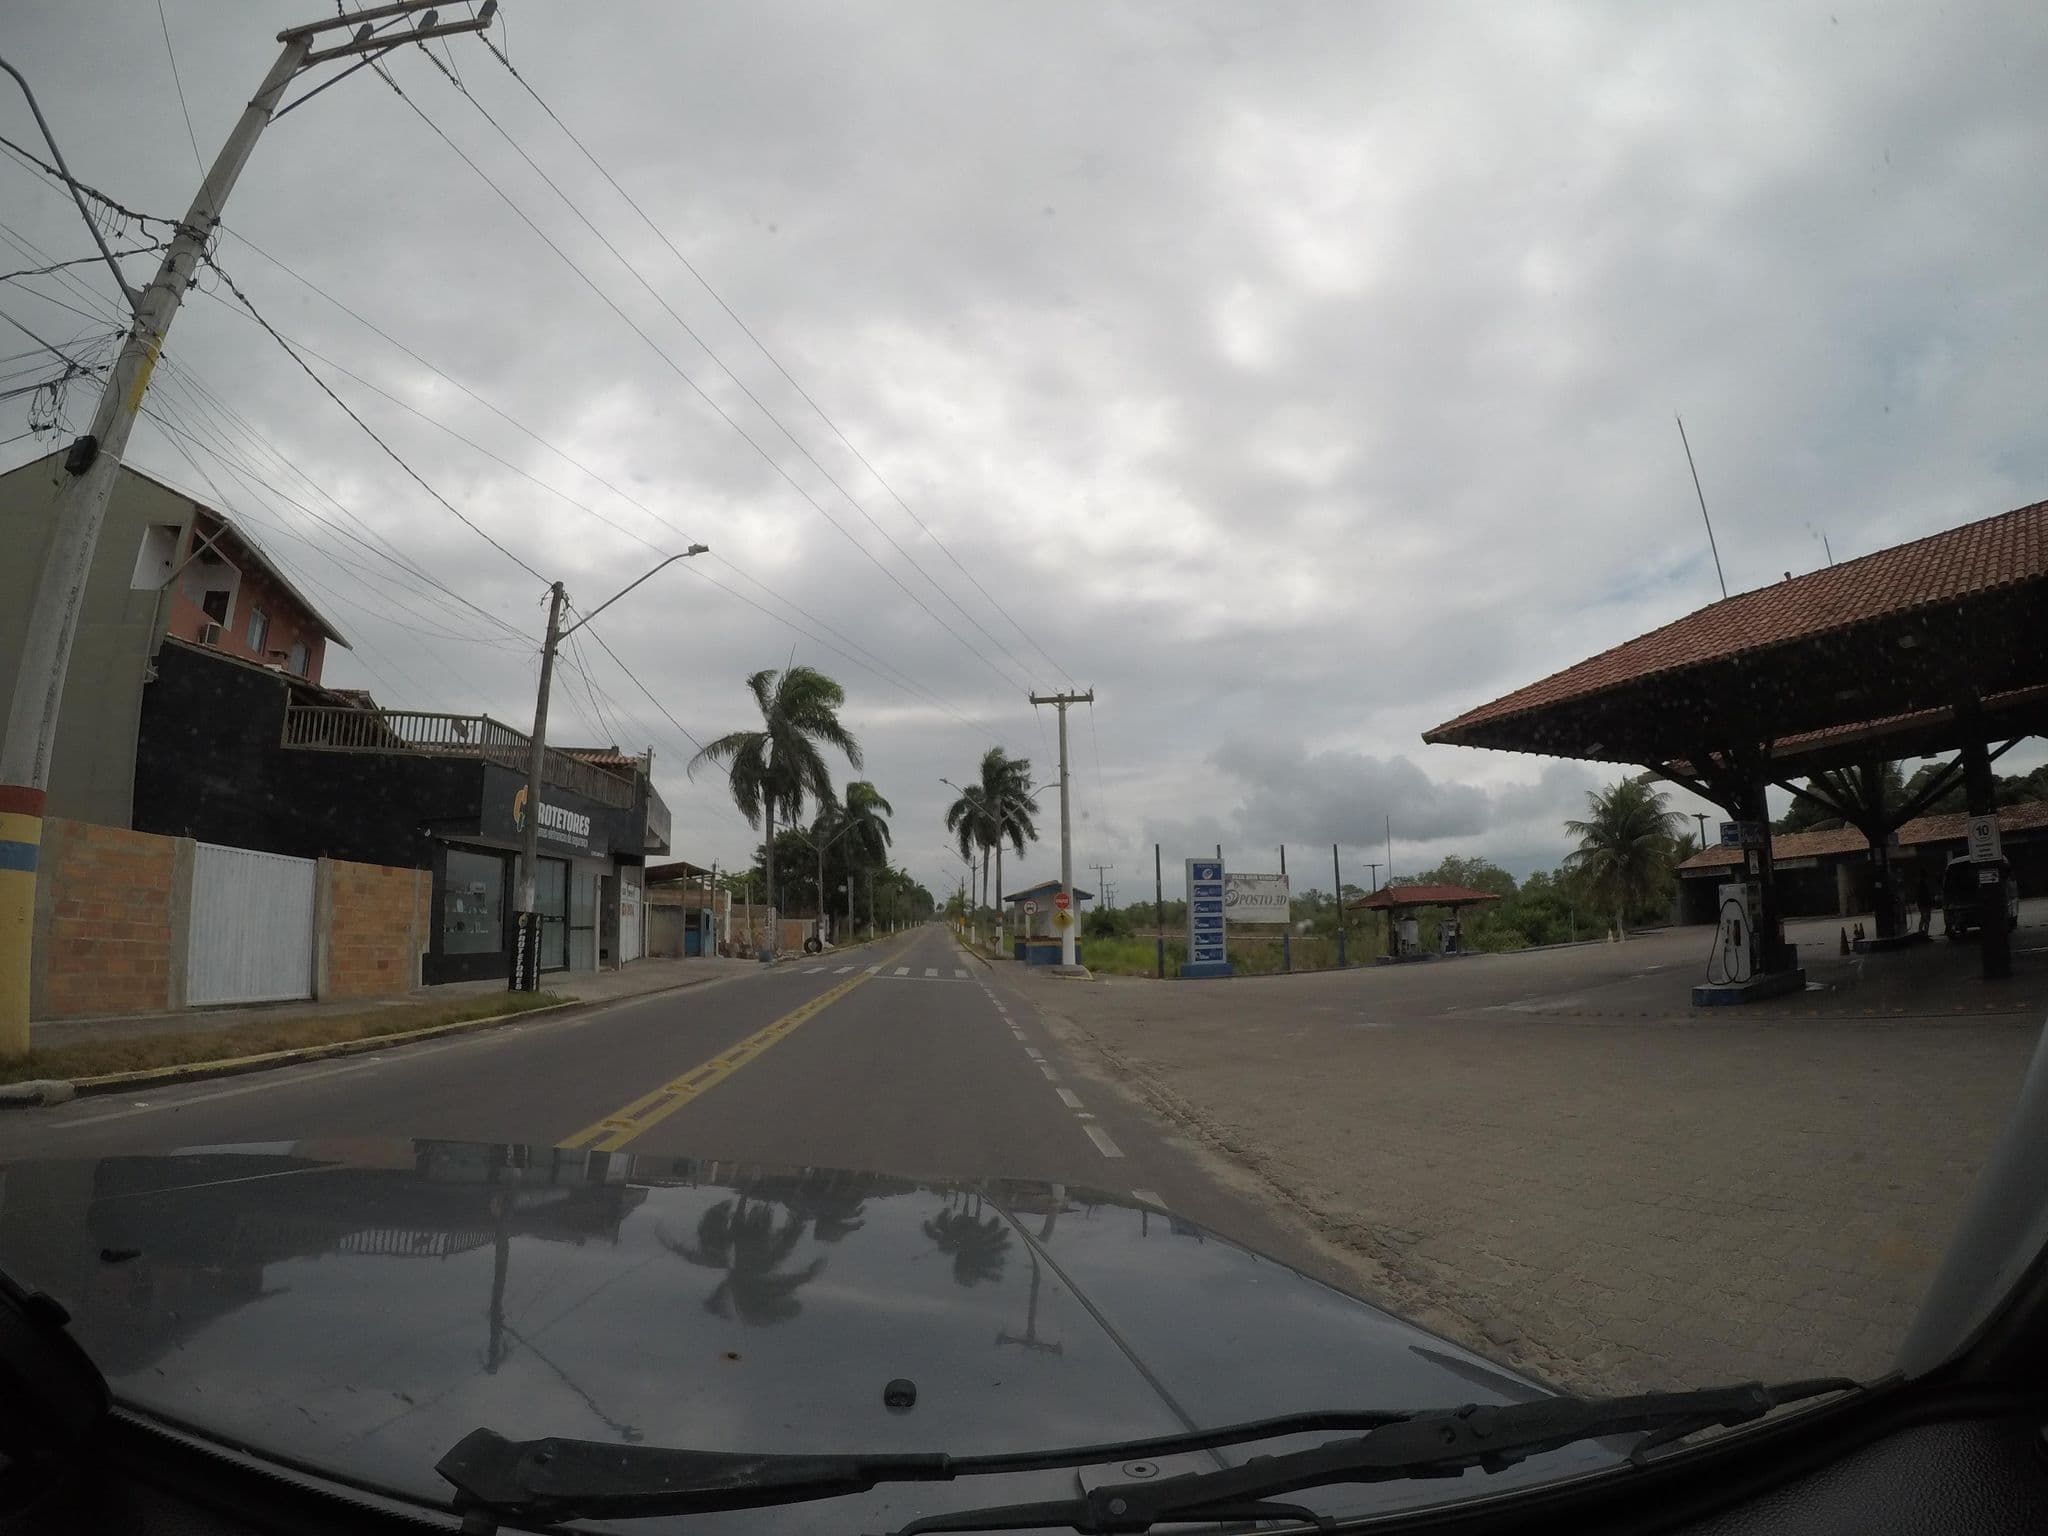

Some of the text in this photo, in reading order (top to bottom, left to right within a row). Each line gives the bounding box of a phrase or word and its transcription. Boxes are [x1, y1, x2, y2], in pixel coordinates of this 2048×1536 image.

[537, 802, 590, 836] ROTETORES
[1976, 824, 1989, 836] 10
[1239, 894, 1272, 905] POSTO
